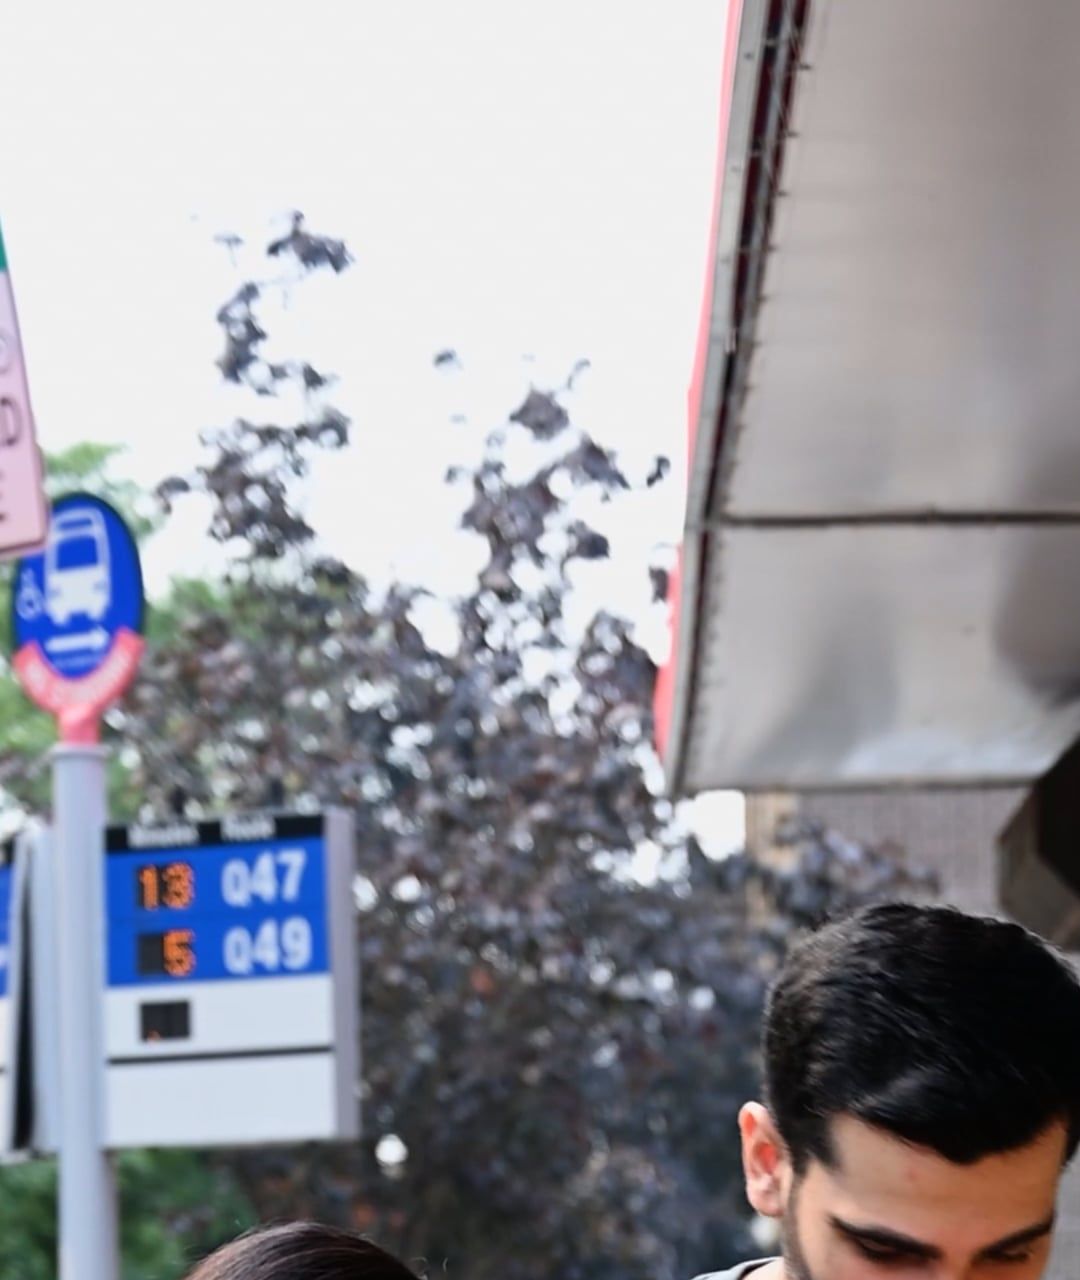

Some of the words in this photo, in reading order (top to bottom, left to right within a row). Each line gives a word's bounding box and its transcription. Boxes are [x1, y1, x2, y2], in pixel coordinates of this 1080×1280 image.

[139, 862, 194, 911] 13
[220, 849, 307, 907] Q47
[163, 929, 196, 977] 5
[222, 916, 313, 975] Q49
